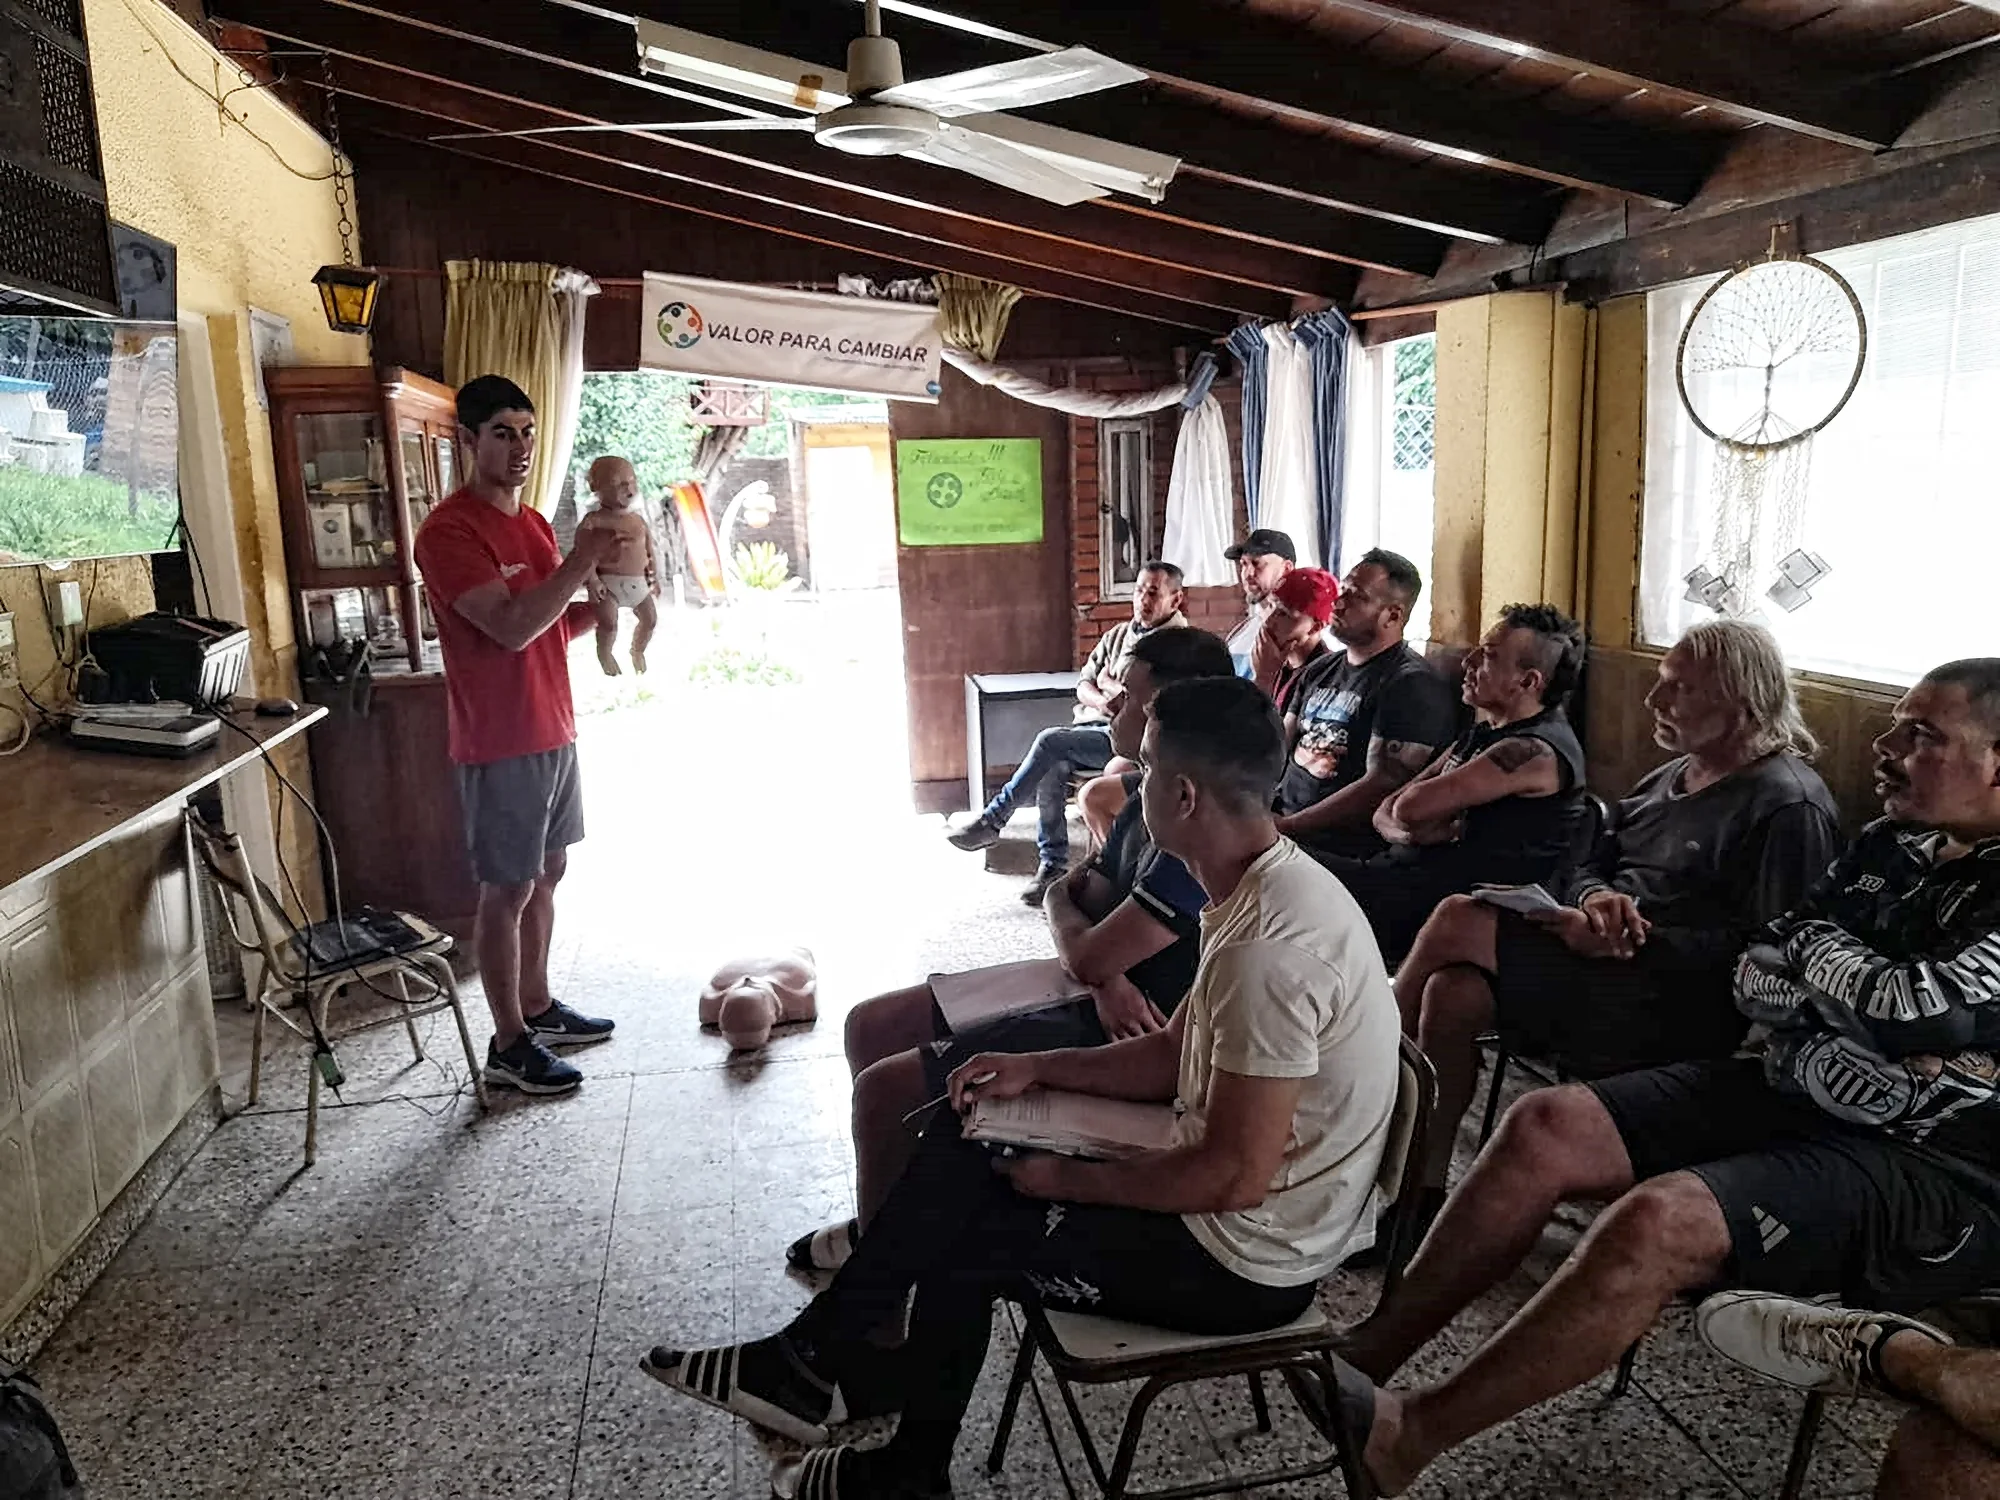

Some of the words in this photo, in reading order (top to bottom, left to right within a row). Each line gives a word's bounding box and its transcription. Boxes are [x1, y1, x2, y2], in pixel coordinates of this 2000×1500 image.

[707, 323, 774, 346] VALOR
[779, 330, 831, 353] PARA
[837, 338, 928, 363] CAMBIAR
